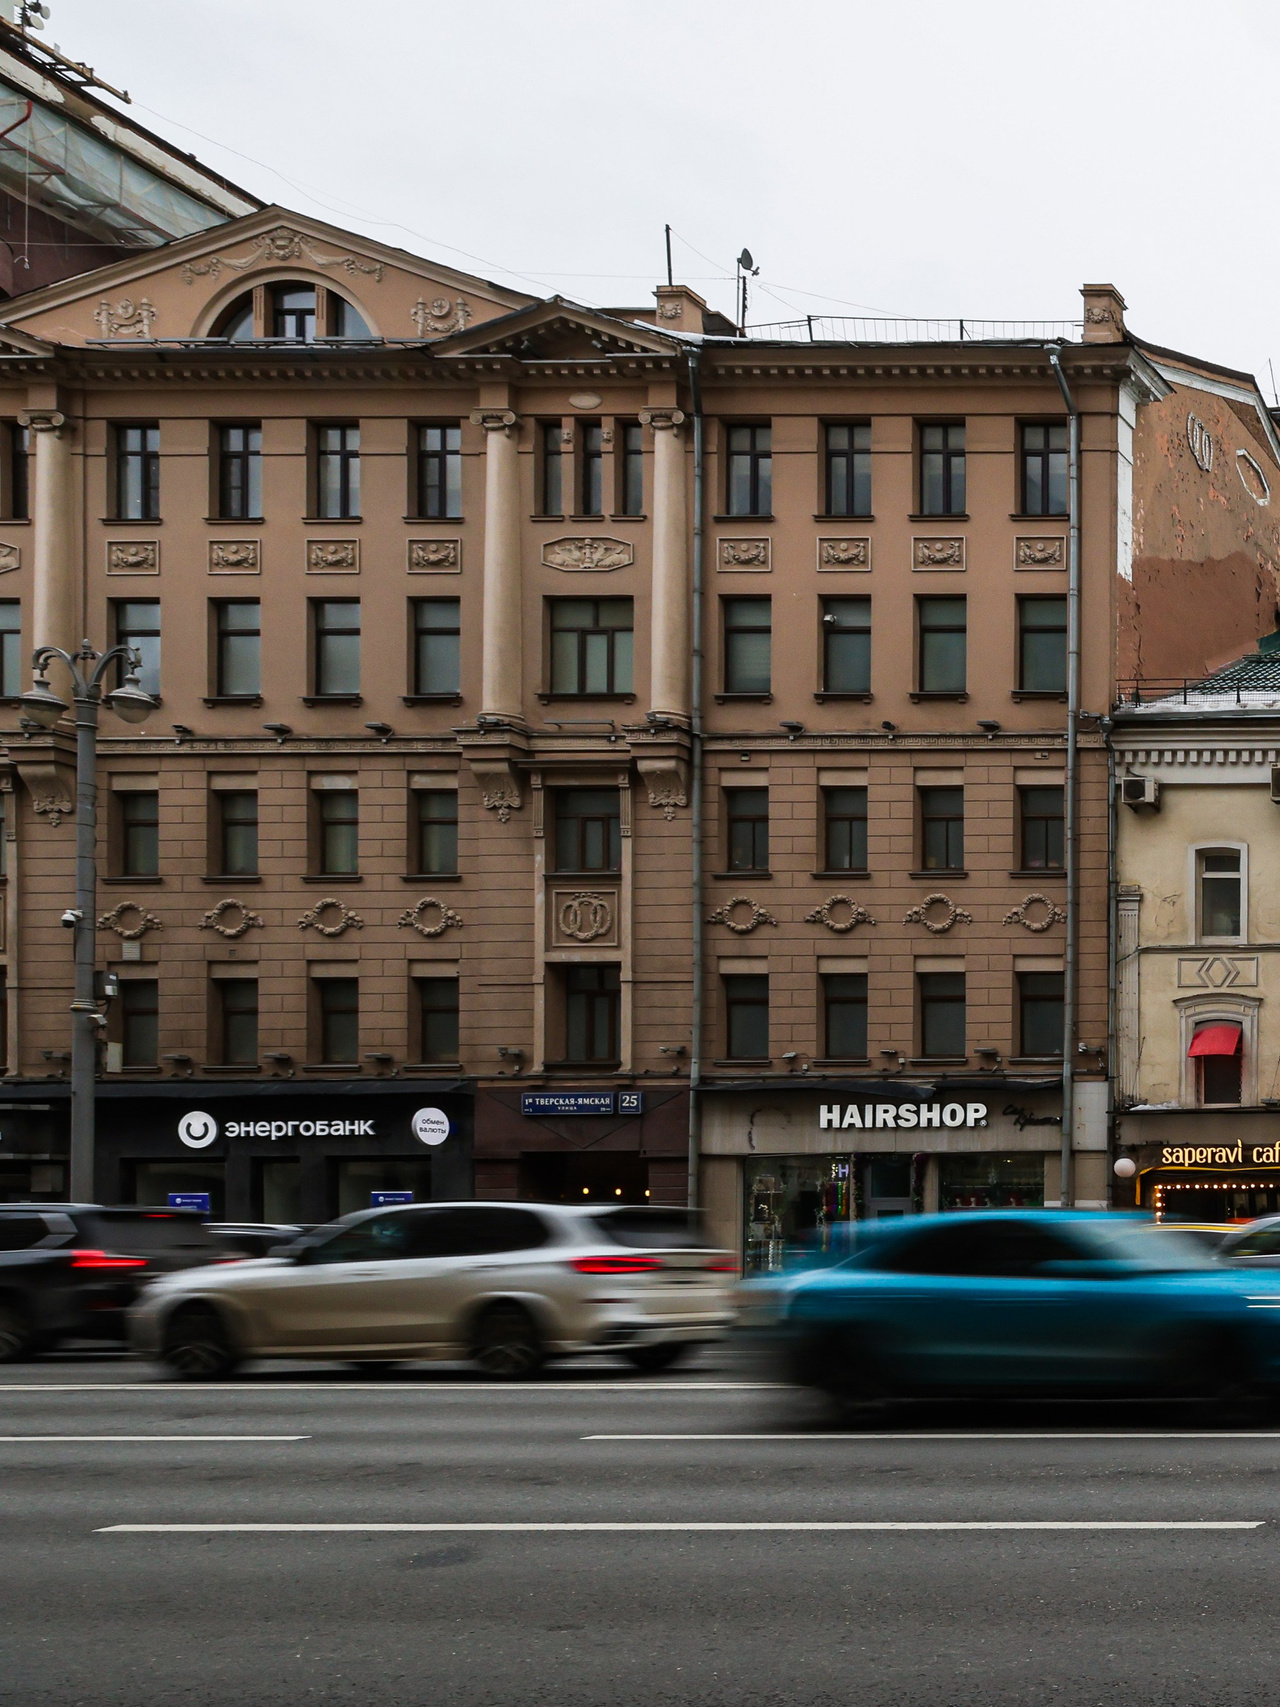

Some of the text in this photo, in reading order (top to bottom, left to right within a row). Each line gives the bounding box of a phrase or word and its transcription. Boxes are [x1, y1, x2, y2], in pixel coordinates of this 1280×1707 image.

[535, 1097, 610, 1106] ТВЕРСКАЯ-ЯМСКАЯ
[621, 1095, 638, 1107] 25
[421, 1117, 445, 1126] обмен
[225, 1119, 376, 1140] энергобанк
[418, 1126, 447, 1134] валюты
[1162, 1138, 1243, 1167] saperavi
